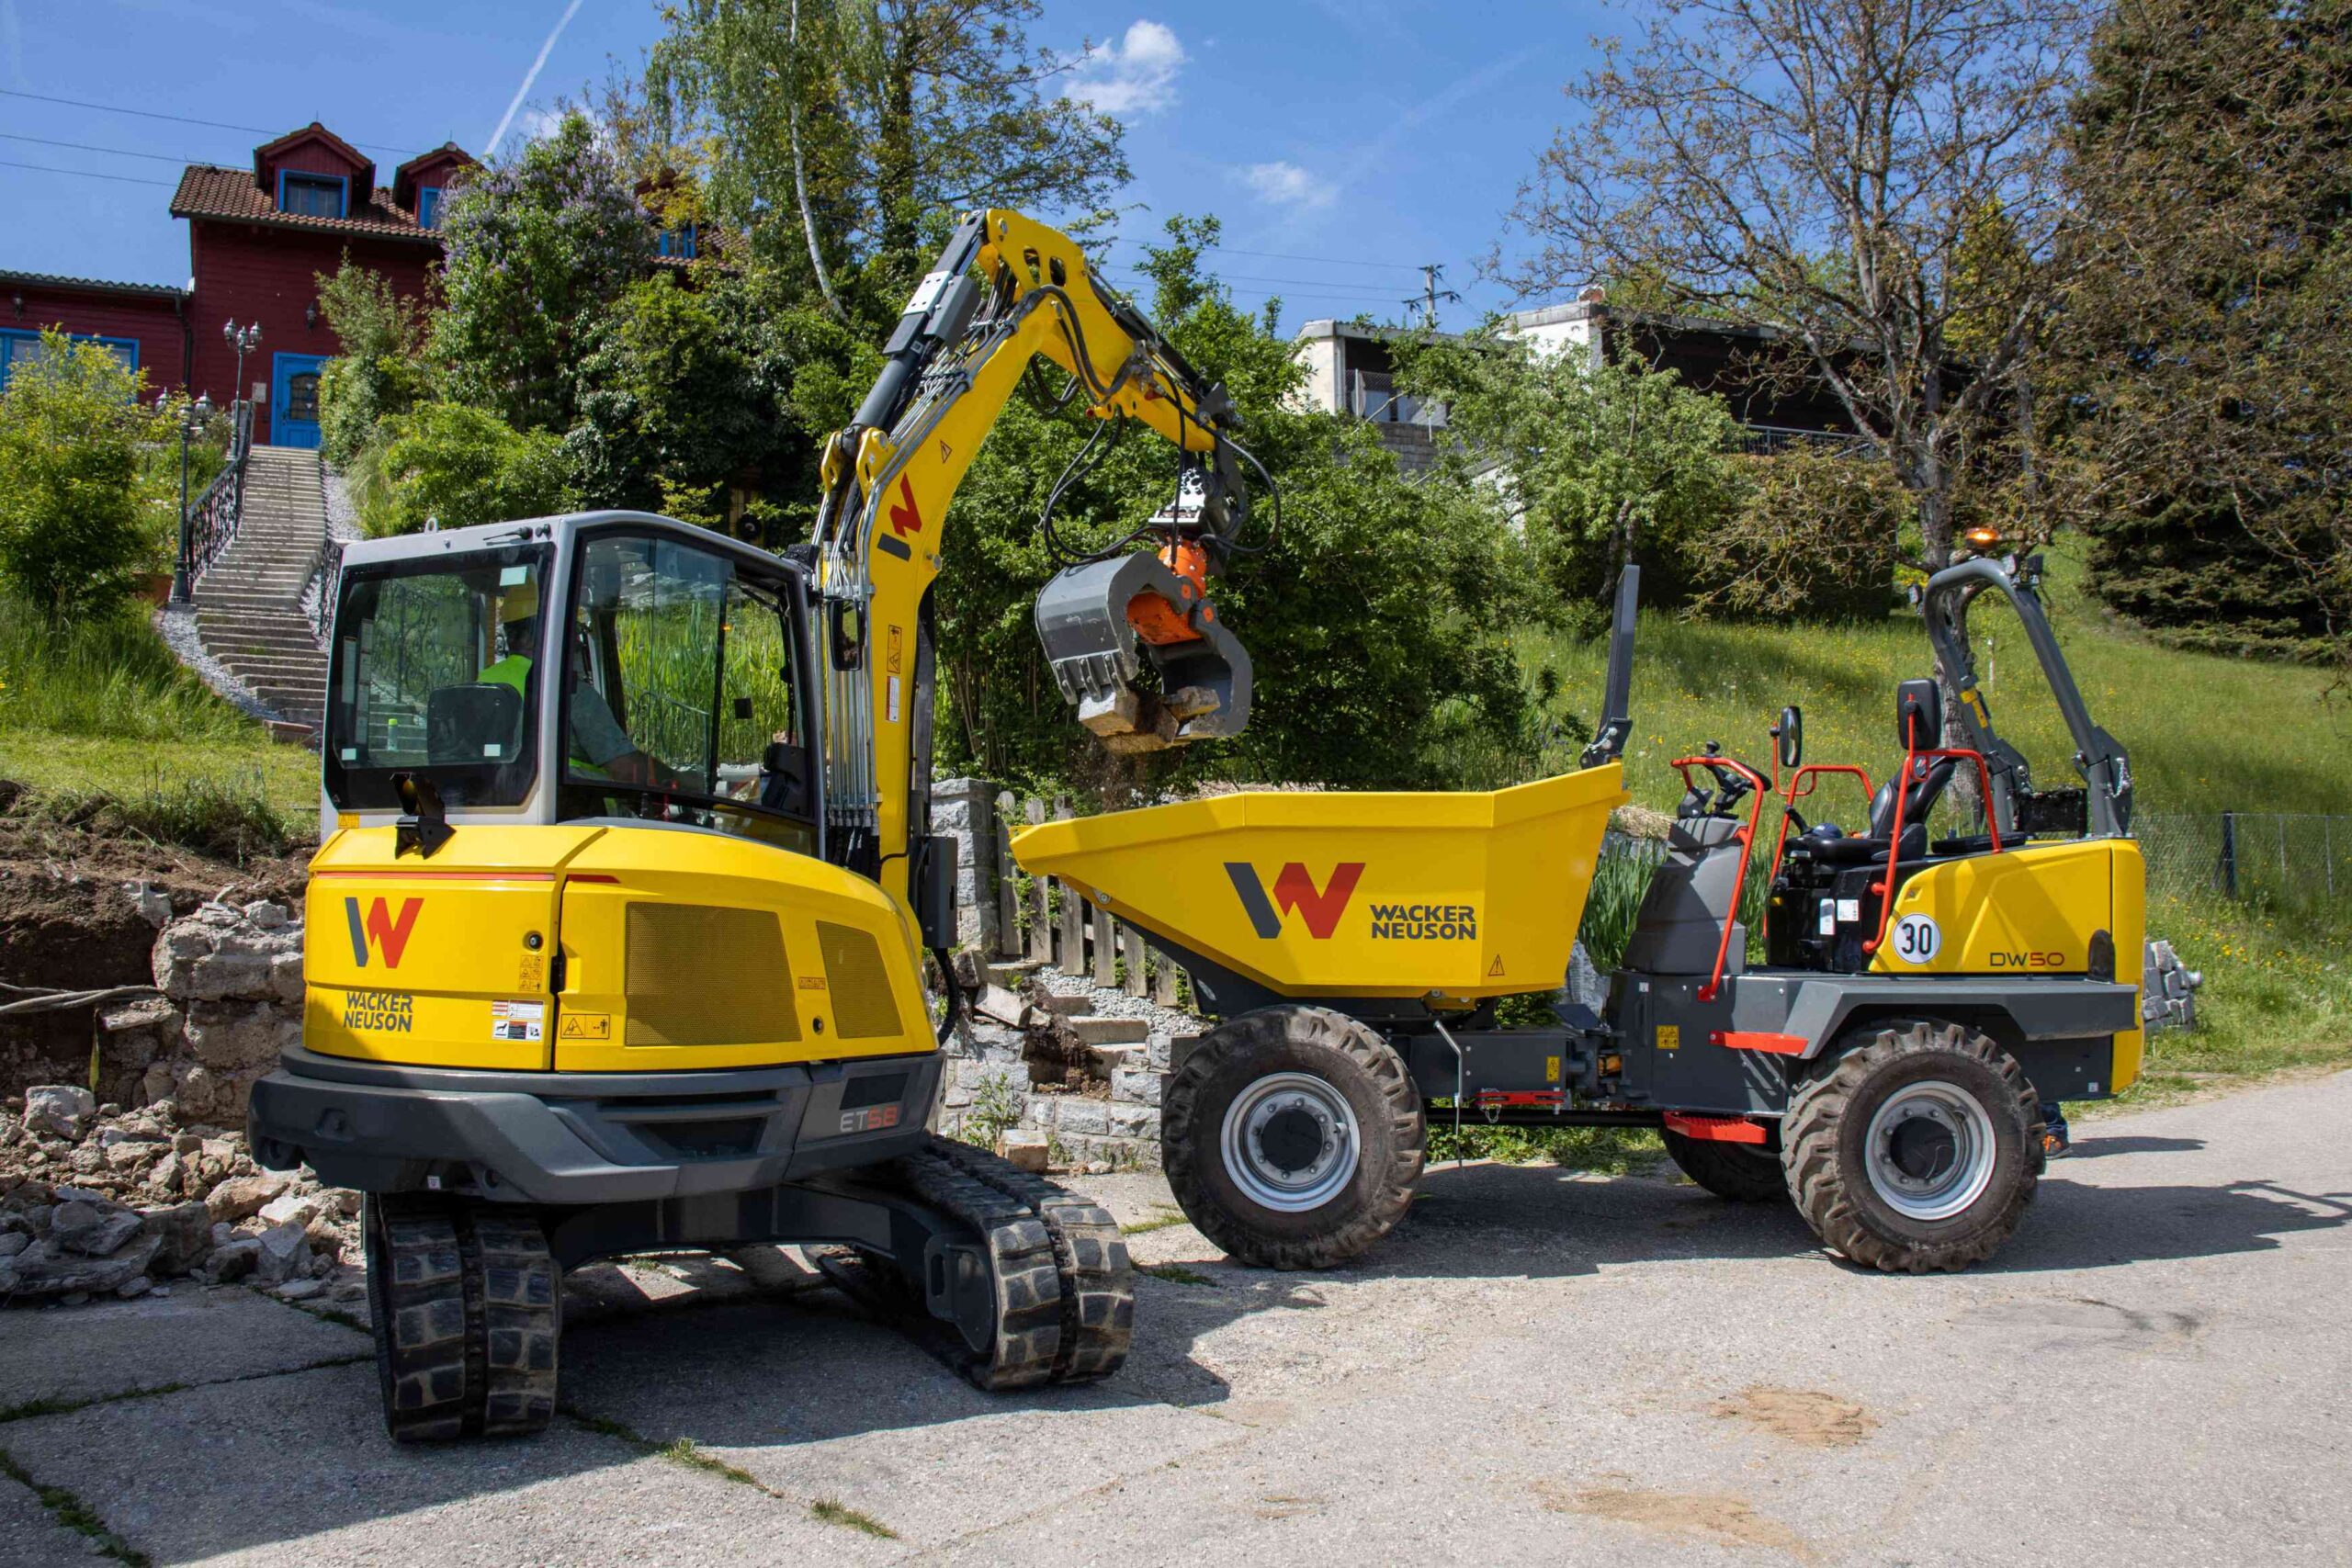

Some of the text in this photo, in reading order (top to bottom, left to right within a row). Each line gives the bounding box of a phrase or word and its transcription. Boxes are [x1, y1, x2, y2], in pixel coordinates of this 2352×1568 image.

[1369, 904, 1476, 922] WACKER
[1371, 921, 1476, 941] NEUSON
[1901, 922, 1933, 955] 30
[1989, 952, 2065, 967] DW50
[346, 990, 413, 1013] WACKER
[343, 1010, 413, 1032] NEUSON
[839, 1104, 899, 1133] ET58
